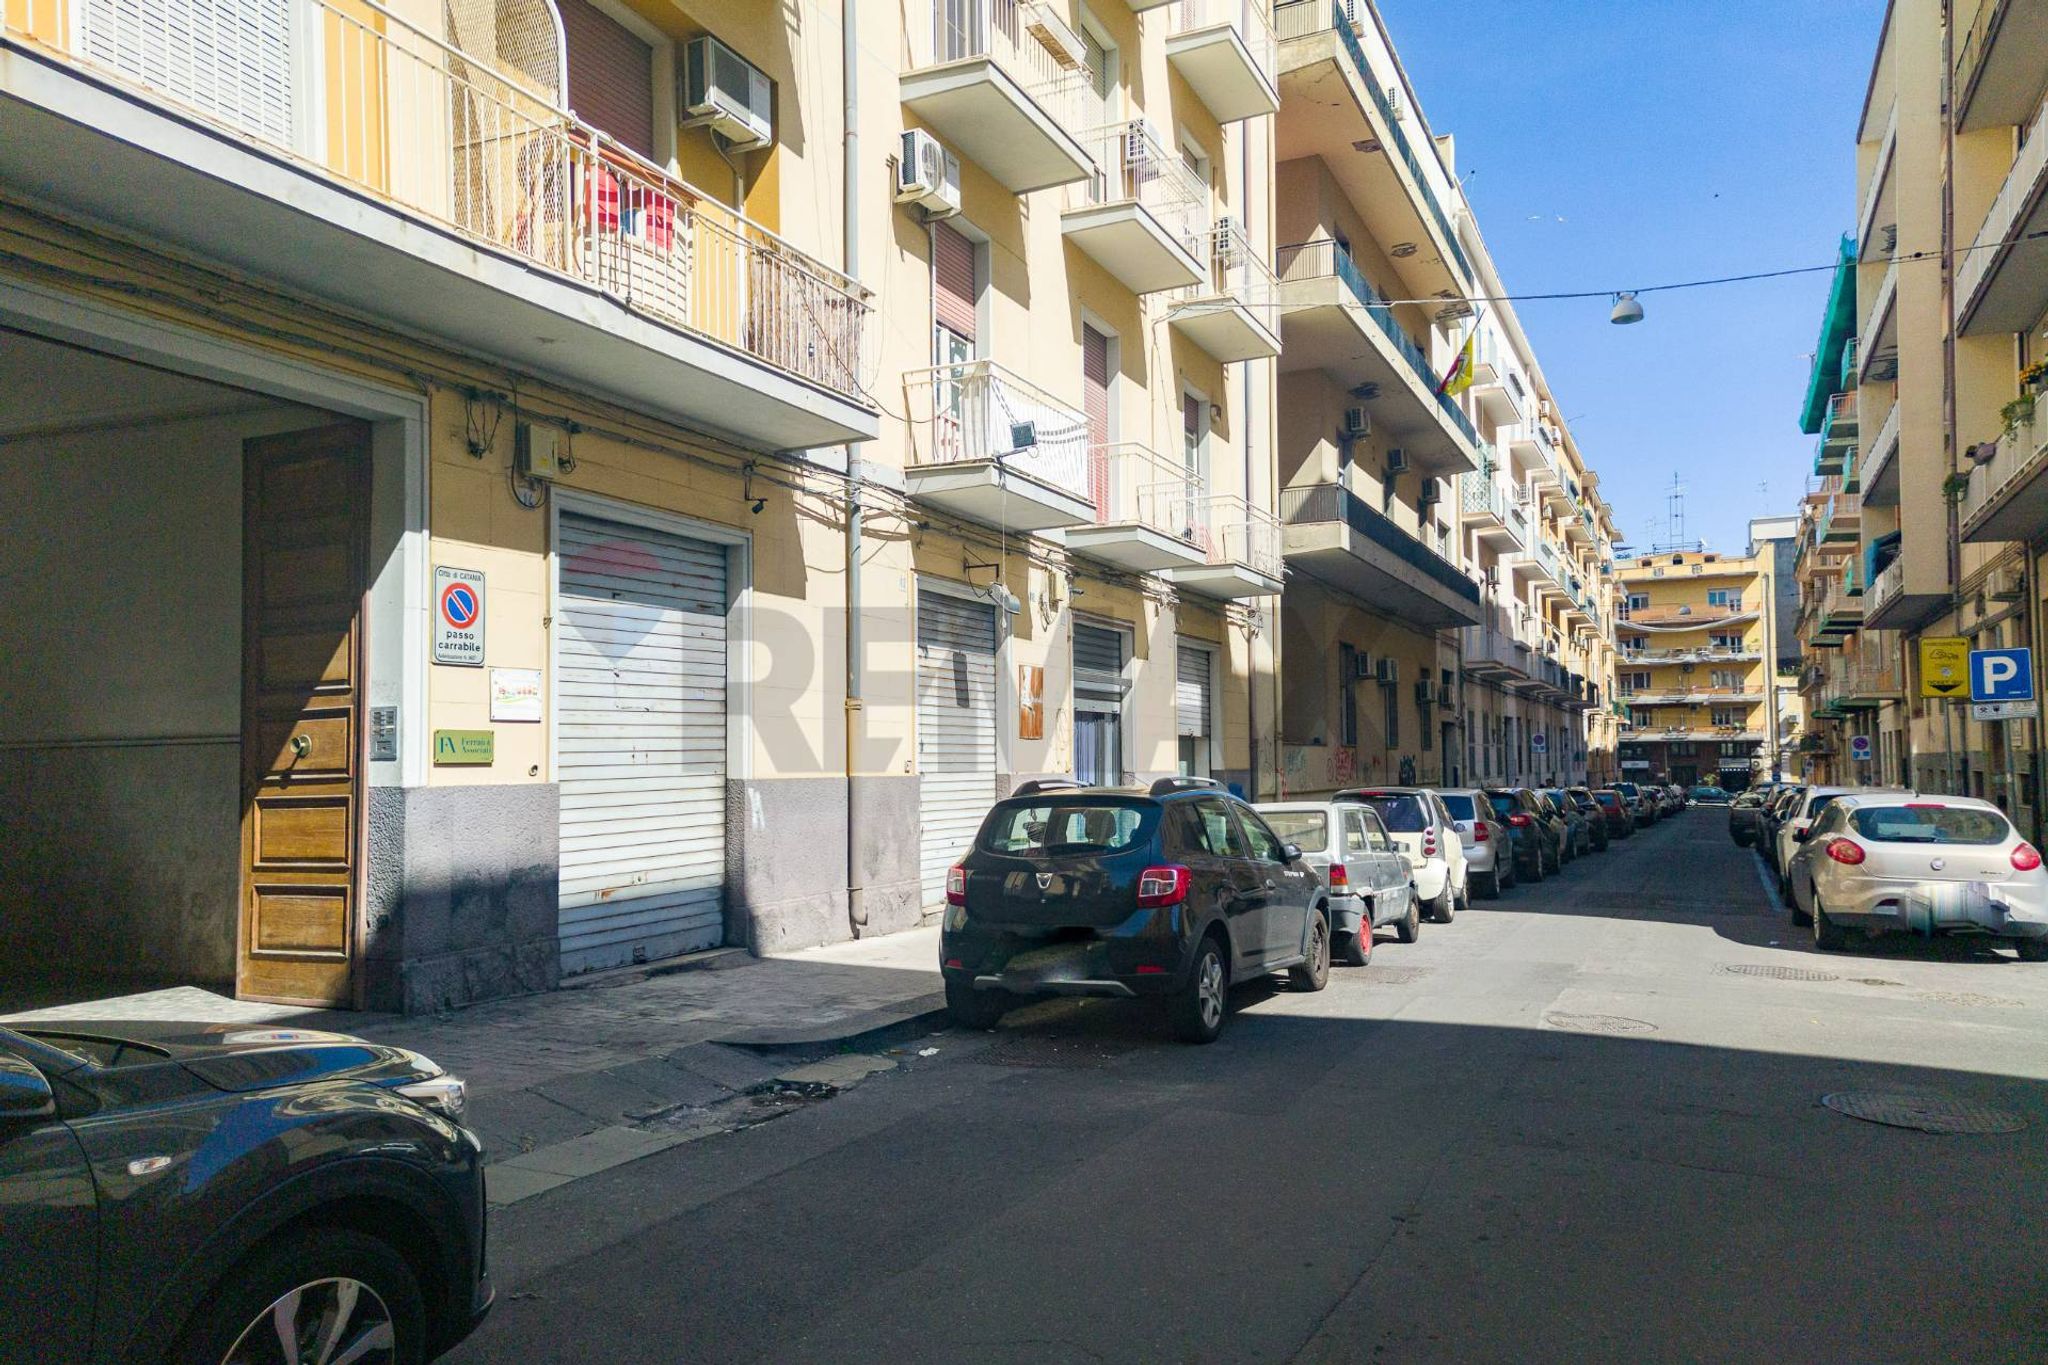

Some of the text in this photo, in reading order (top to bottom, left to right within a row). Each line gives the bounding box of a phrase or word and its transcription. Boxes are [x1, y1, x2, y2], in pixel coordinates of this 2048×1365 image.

[446, 631, 475, 640] passo
[438, 642, 481, 652] carrabile
[1983, 656, 2018, 695] P
